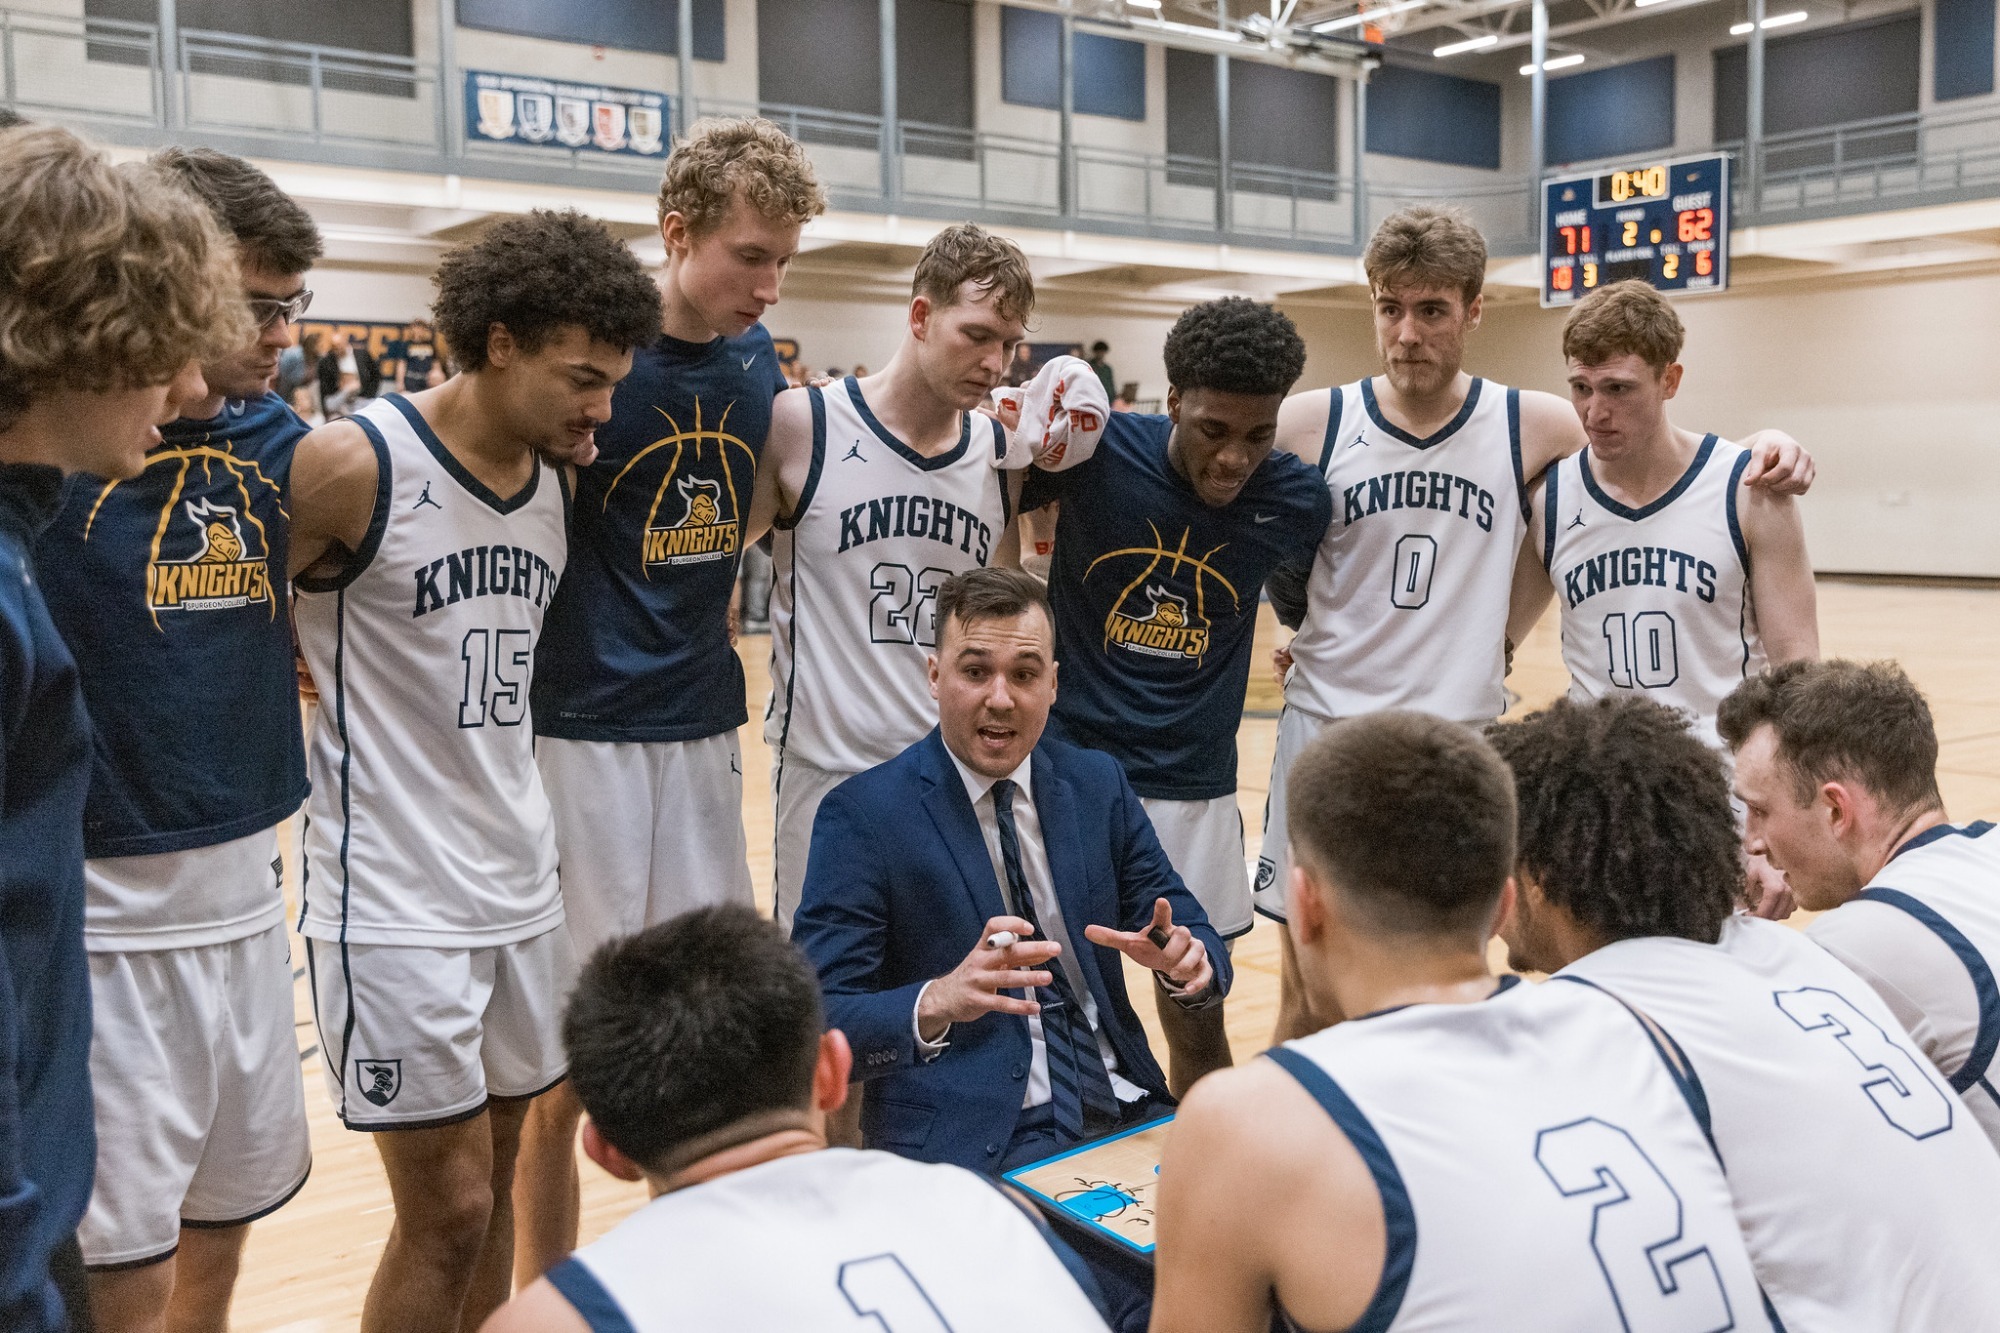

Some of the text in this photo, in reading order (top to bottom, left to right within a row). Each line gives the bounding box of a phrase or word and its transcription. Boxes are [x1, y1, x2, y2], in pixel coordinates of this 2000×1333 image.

[1611, 166, 1666, 202] 0:40
[1560, 226, 1591, 254] 71
[1622, 221, 1638, 246] 2
[1678, 208, 1713, 242] 62
[1583, 263, 1597, 288] 3
[1663, 254, 1679, 279] 2
[1344, 471, 1495, 532] KNIGHTS
[649, 523, 737, 562] KNIGHTS
[838, 495, 991, 567] KNIGHTS
[701, 553, 721, 562] COLLEGE
[1390, 534, 1438, 610] 0
[155, 562, 264, 604] KNIGHTS
[413, 545, 557, 619] KNIGHTS
[1565, 547, 1717, 610] KNIGHTS
[187, 599, 246, 610] SPURGEON COLLEGE
[1109, 616, 1205, 655] KNIGHTS
[1129, 645, 1181, 658] SPURGEON COLLEGE
[1602, 611, 1679, 689] 10
[458, 629, 531, 728] 15
[1772, 986, 1953, 1141] 3
[1534, 1116, 1736, 1333] 2
